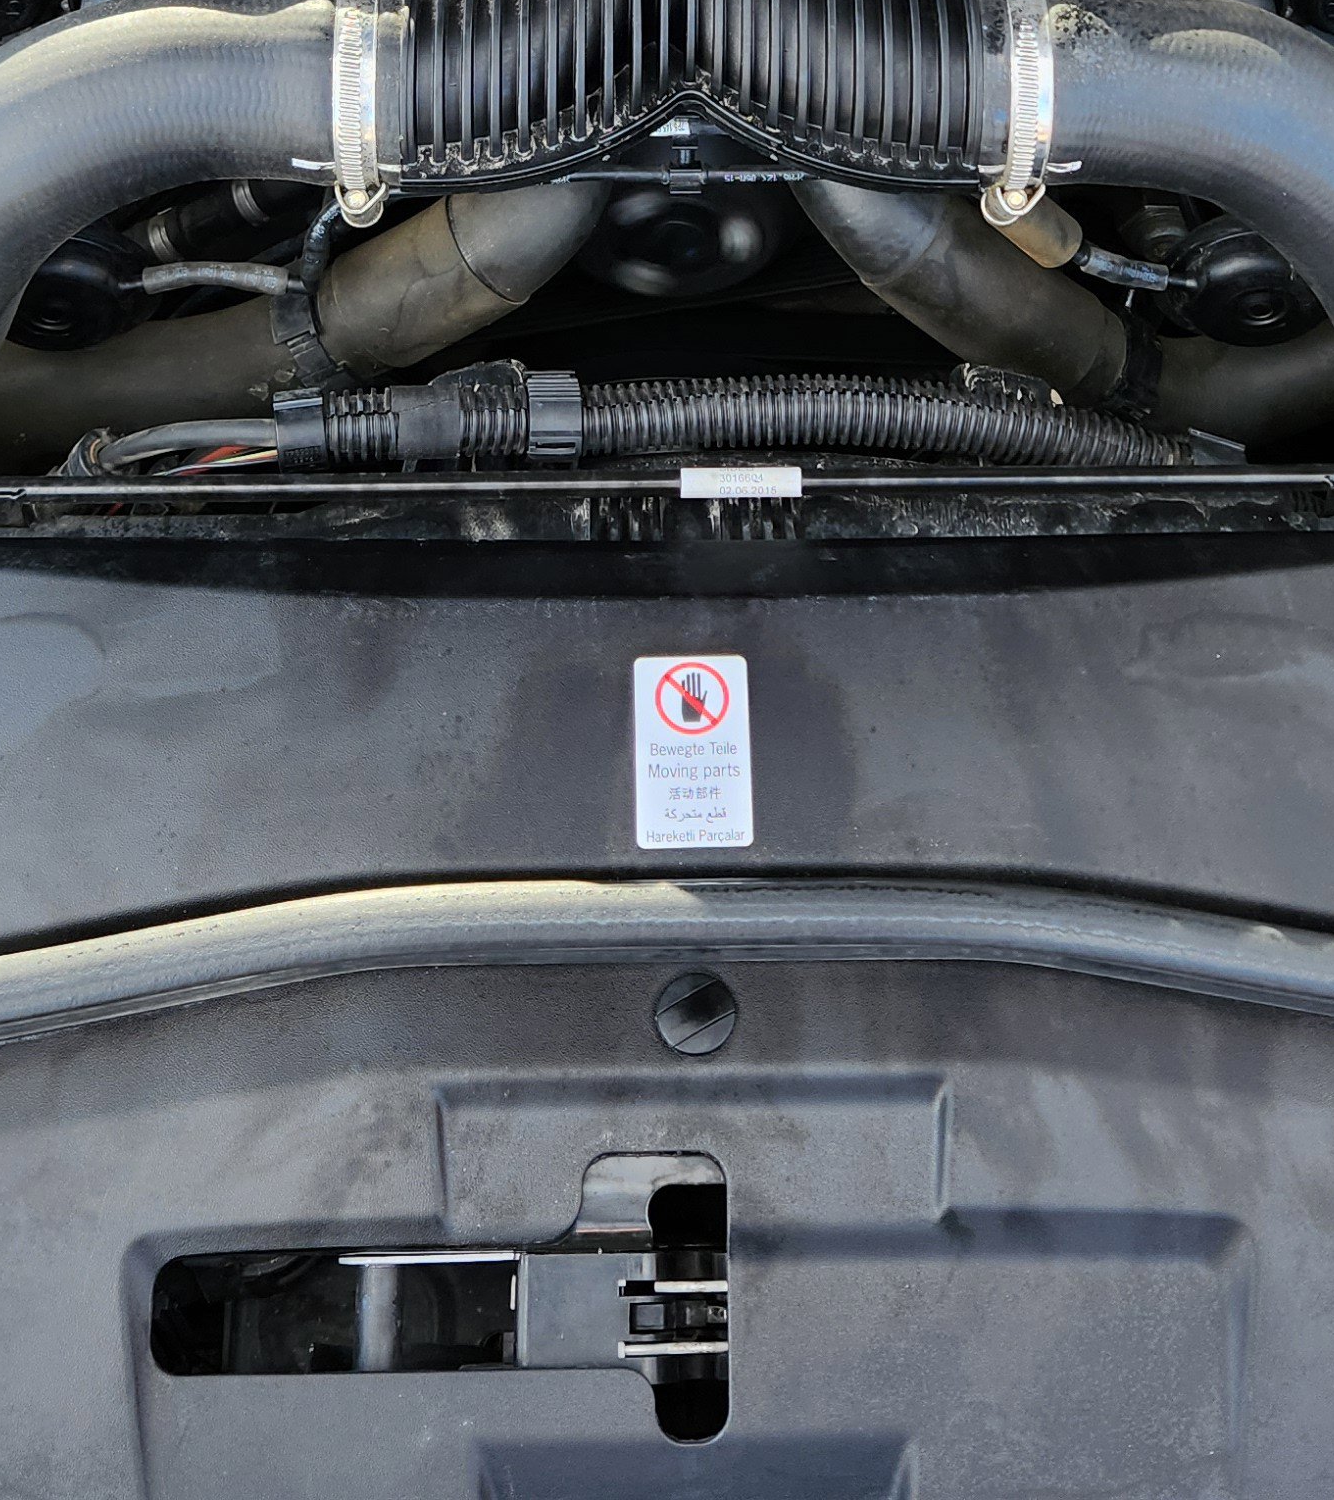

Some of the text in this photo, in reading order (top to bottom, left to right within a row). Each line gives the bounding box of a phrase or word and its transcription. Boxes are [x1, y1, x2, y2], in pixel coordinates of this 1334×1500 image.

[650, 741, 737, 758] Bewegte Teile
[648, 763, 740, 780] Moving parts
[669, 786, 721, 800] 活动部件
[699, 829, 745, 843] Parçalar
